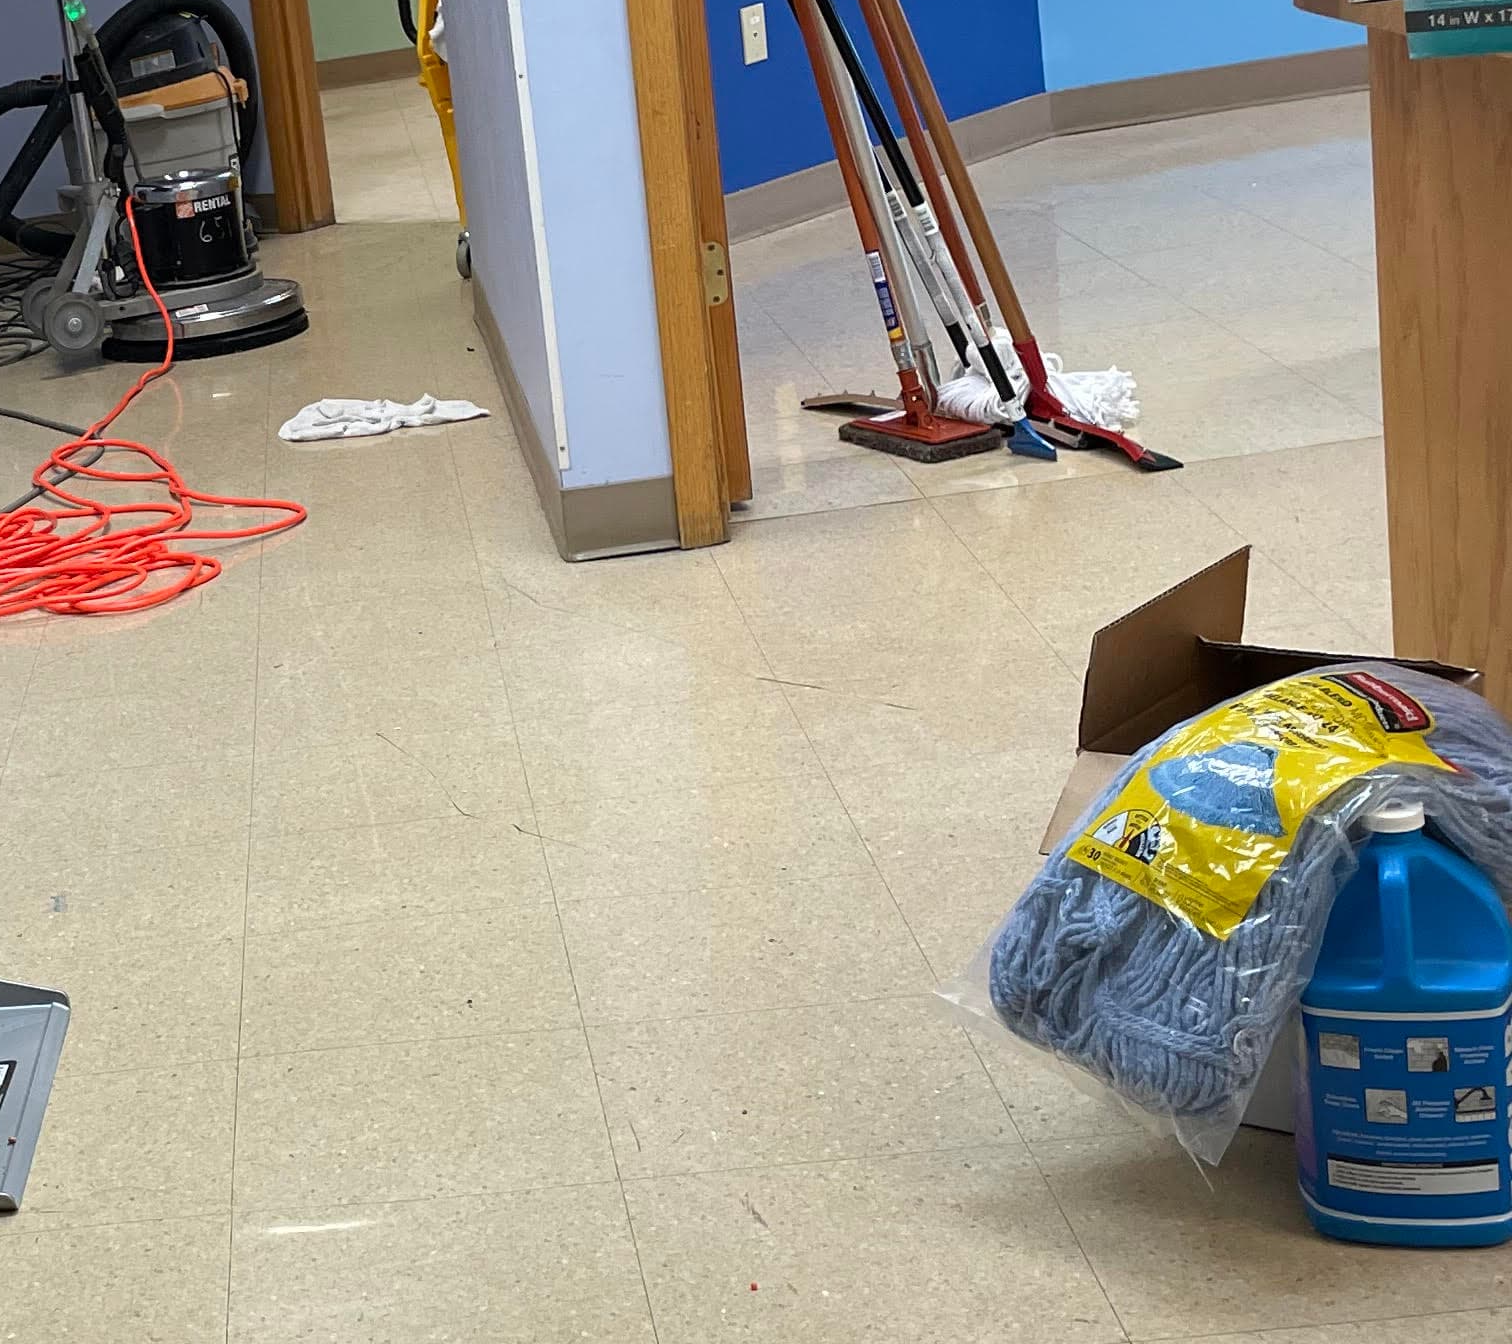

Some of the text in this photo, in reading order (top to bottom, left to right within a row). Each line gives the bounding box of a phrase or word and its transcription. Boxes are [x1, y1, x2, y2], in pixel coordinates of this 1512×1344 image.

[1428, 14, 1445, 27] 14
[1464, 11, 1480, 24] W
[1484, 13, 1494, 23] x
[193, 194, 232, 214] RENTAL
